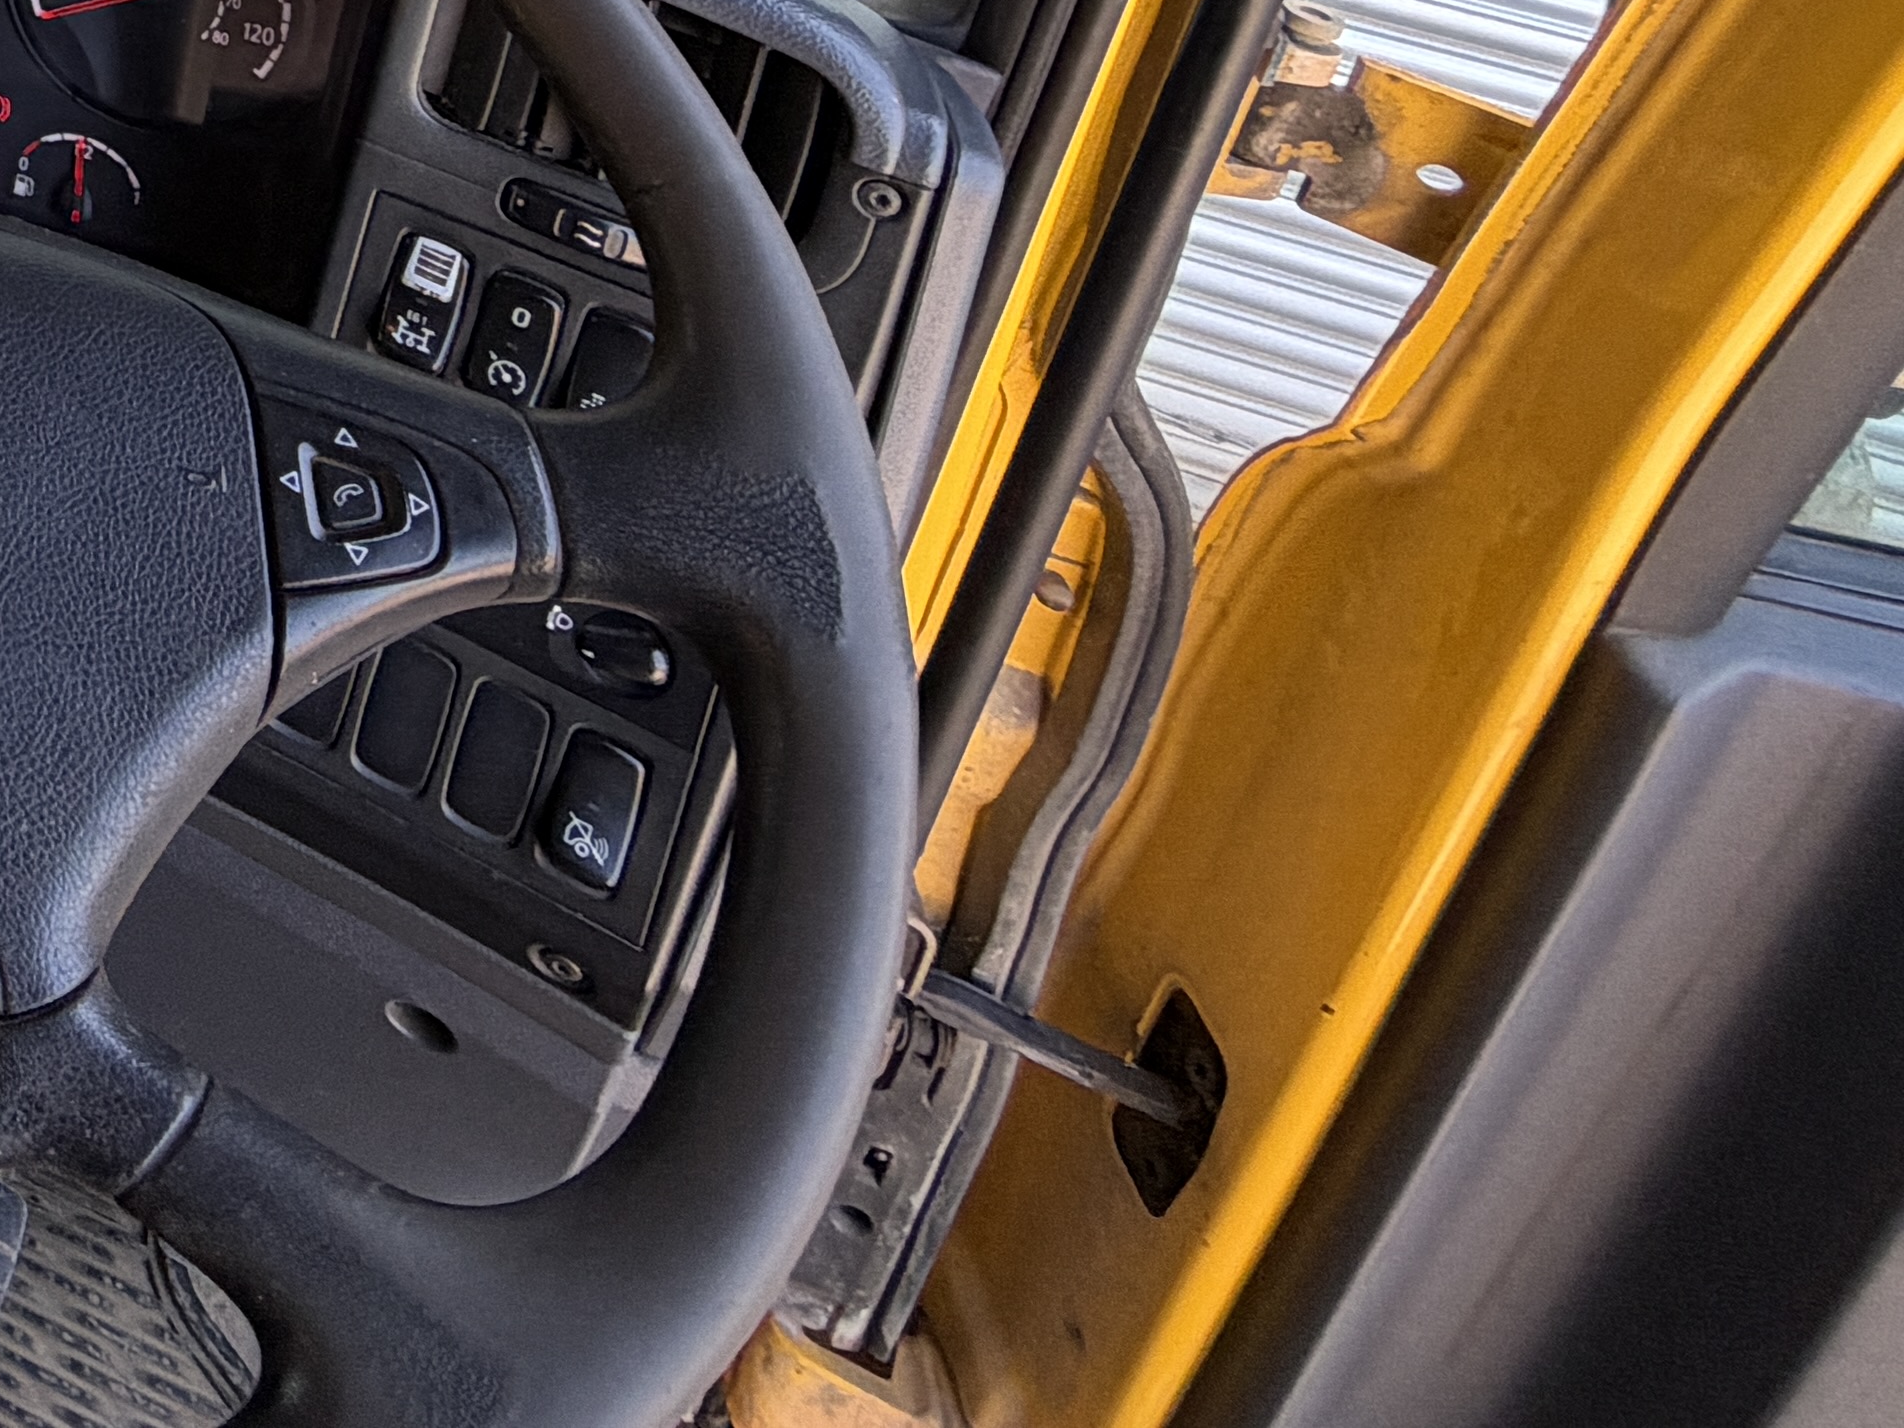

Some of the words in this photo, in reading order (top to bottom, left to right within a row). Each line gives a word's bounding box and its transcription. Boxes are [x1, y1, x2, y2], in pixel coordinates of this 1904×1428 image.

[211, 29, 230, 46] 80
[242, 21, 275, 46] 120
[18, 156, 29, 171] 0
